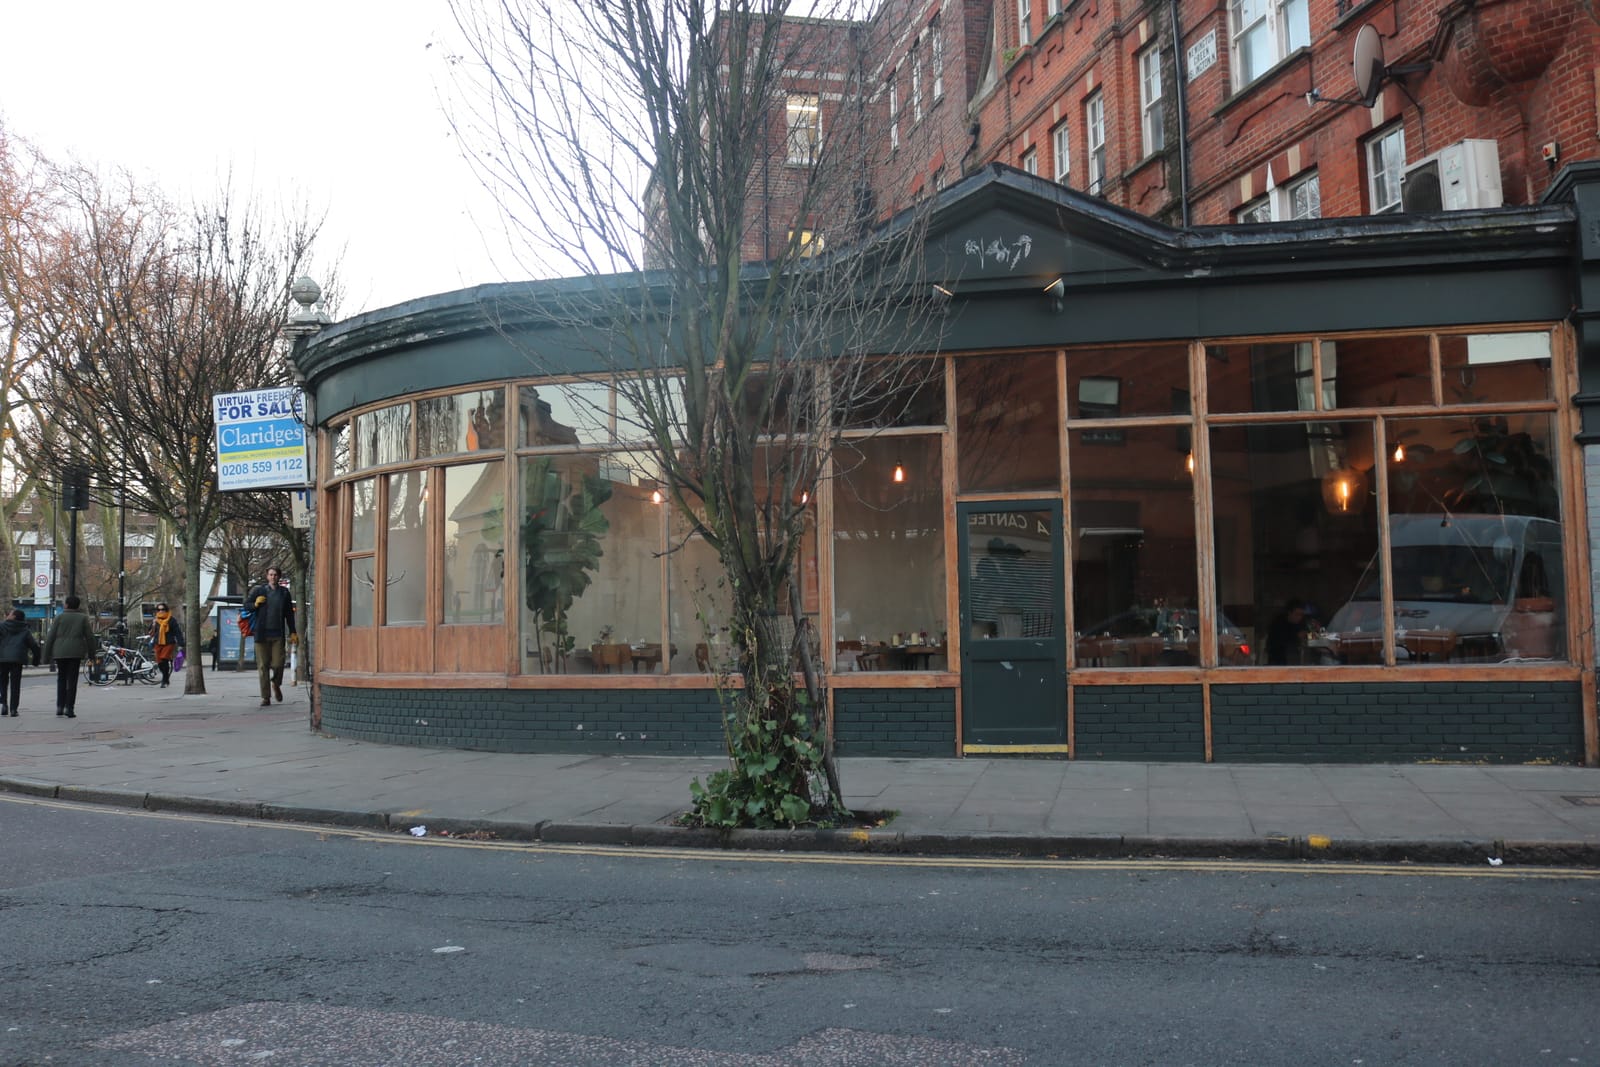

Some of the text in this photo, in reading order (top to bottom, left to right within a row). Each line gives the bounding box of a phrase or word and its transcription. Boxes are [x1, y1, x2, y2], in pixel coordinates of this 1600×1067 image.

[1193, 45, 1209, 66] GREEN
[217, 395, 254, 407] VIRTUAL
[218, 399, 303, 420] FOR SALE
[221, 424, 302, 446] Claridges
[222, 458, 303, 476] 0208 559 1122
